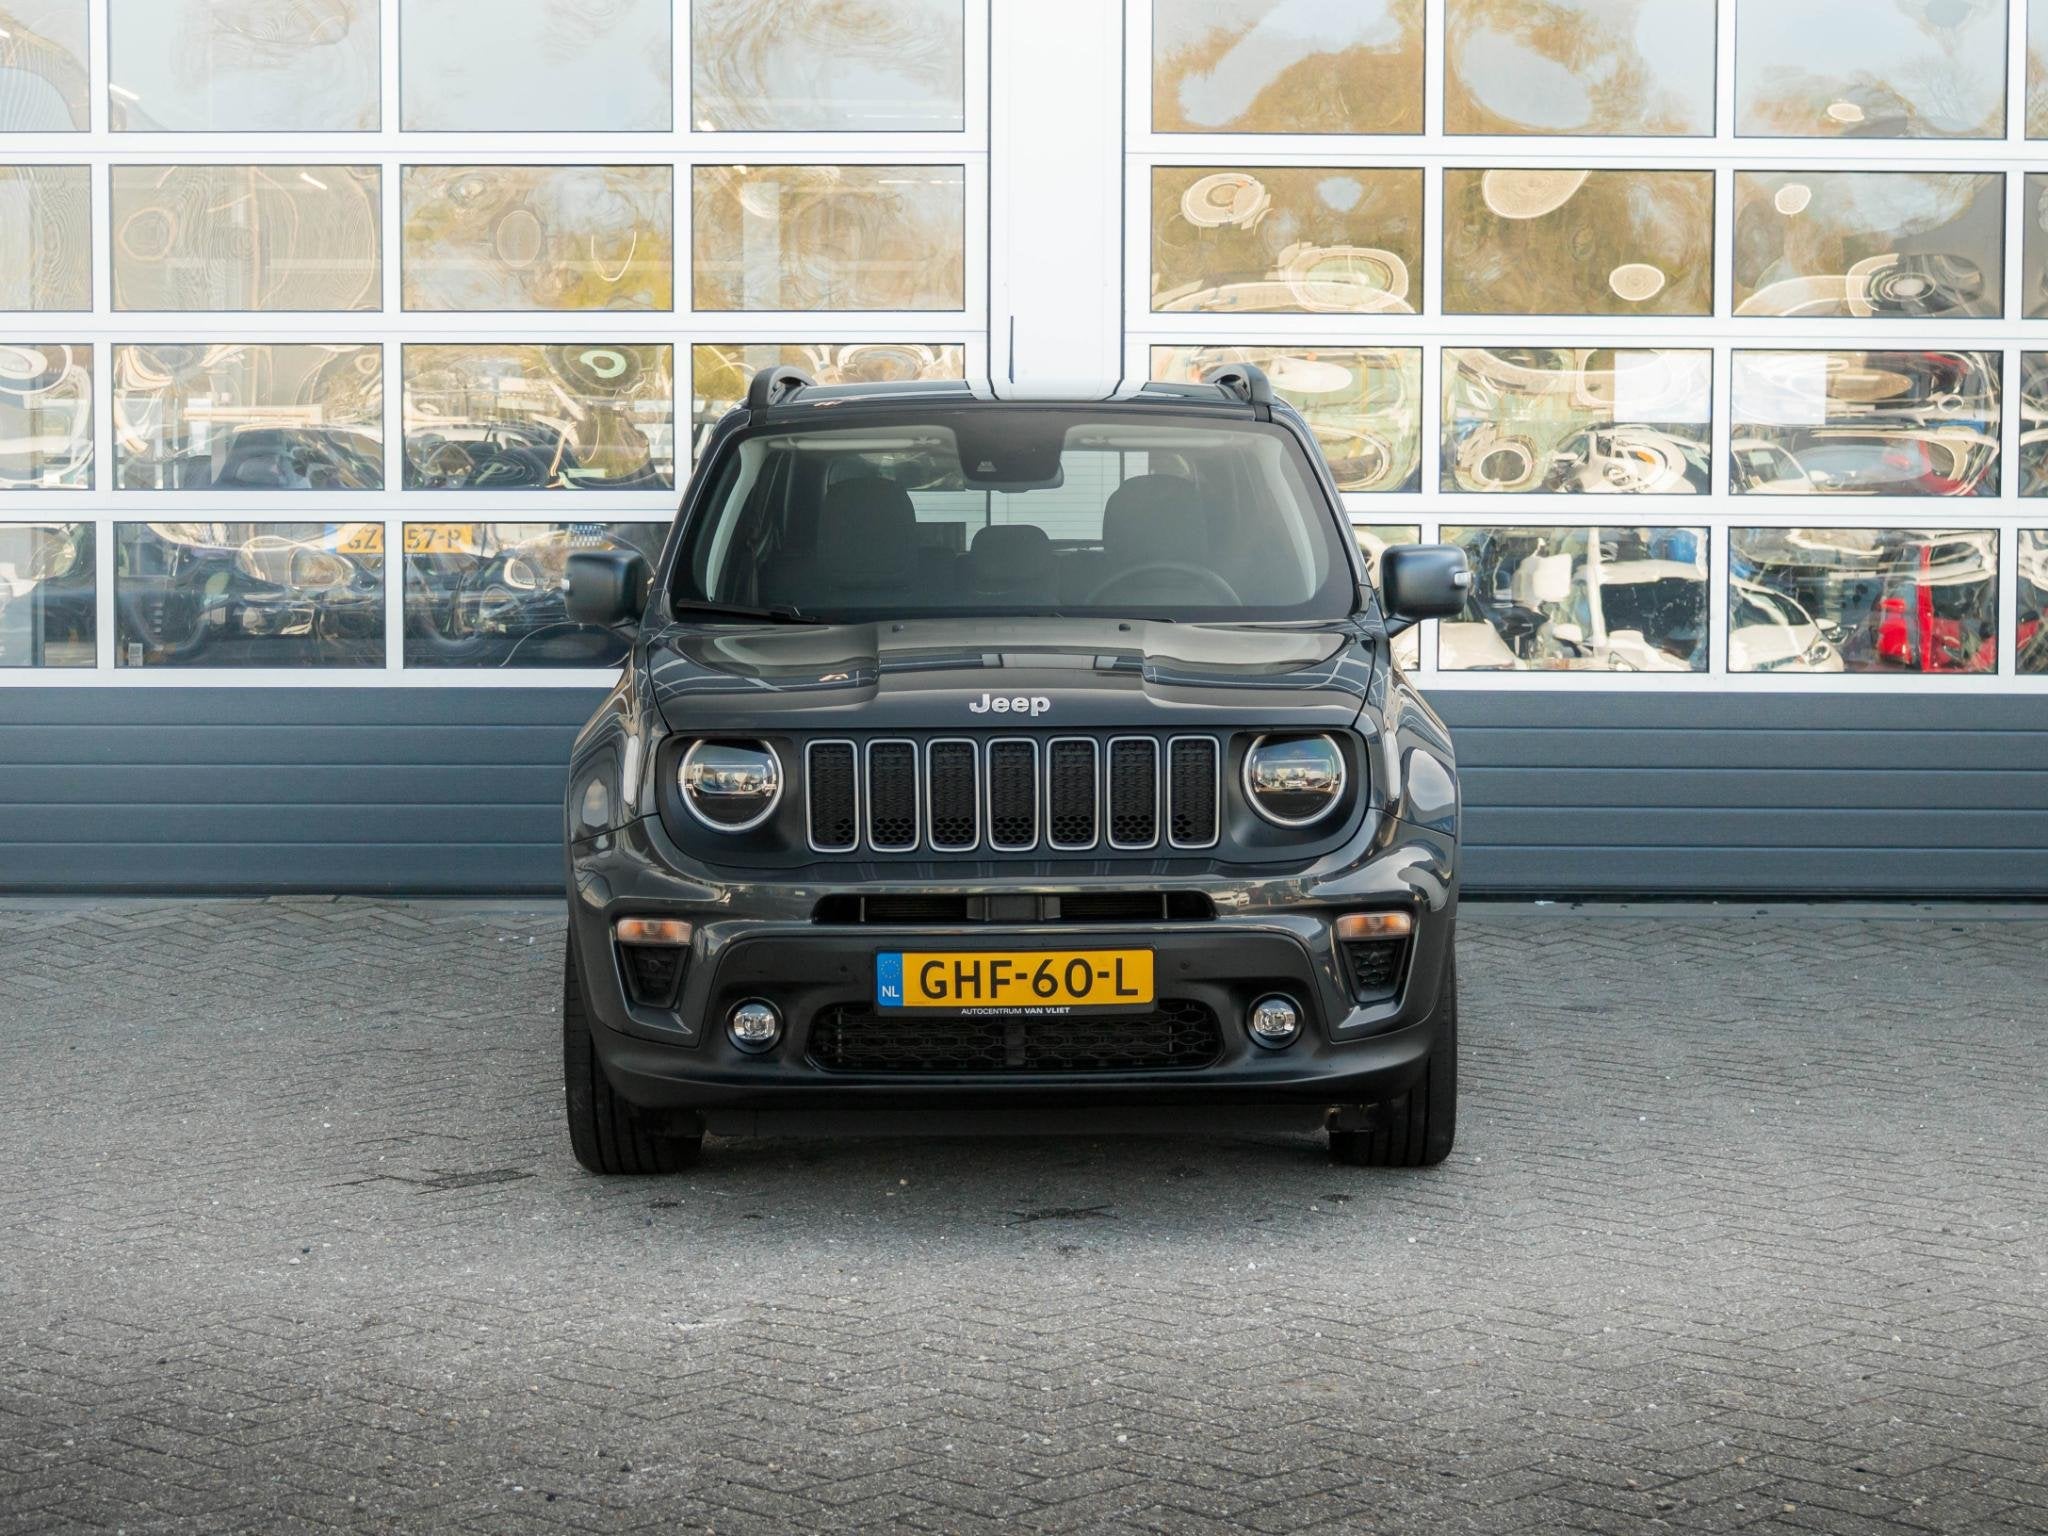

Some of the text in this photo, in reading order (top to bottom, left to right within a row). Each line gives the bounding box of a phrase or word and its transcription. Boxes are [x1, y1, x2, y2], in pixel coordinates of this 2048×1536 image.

[968, 693, 1051, 717] Jeep
[919, 957, 1139, 999] GHF-60-L
[882, 985, 900, 998] NL
[961, 1007, 1022, 1015] AUTOCENTRUM
[1045, 1006, 1071, 1014] VLIET
